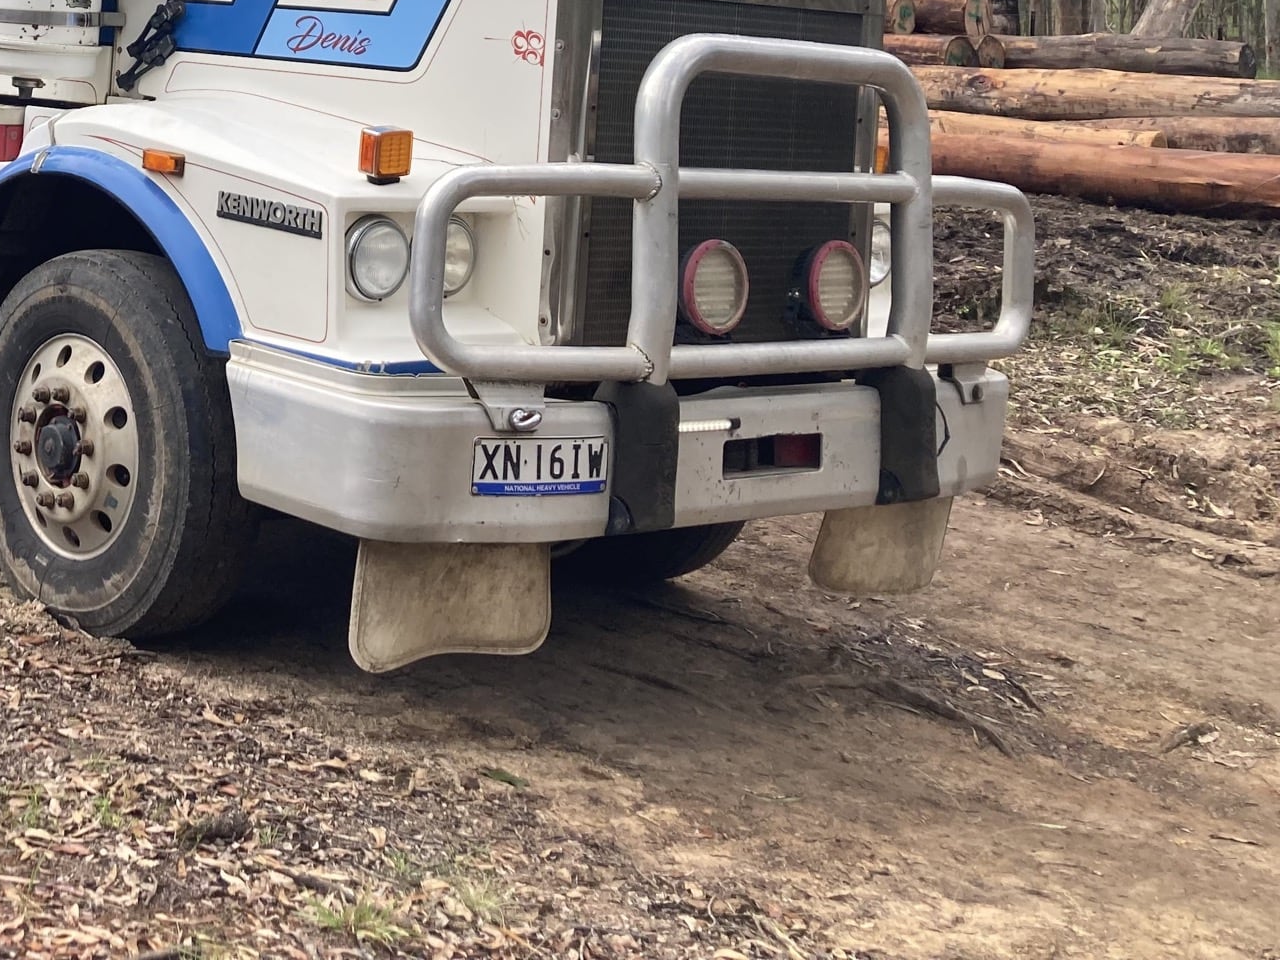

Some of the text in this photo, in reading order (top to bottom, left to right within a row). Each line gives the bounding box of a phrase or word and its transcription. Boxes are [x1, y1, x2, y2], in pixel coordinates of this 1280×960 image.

[286, 15, 373, 56] Denis
[217, 190, 322, 232] KENWORTH
[557, 483, 581, 491] VEHICLE
